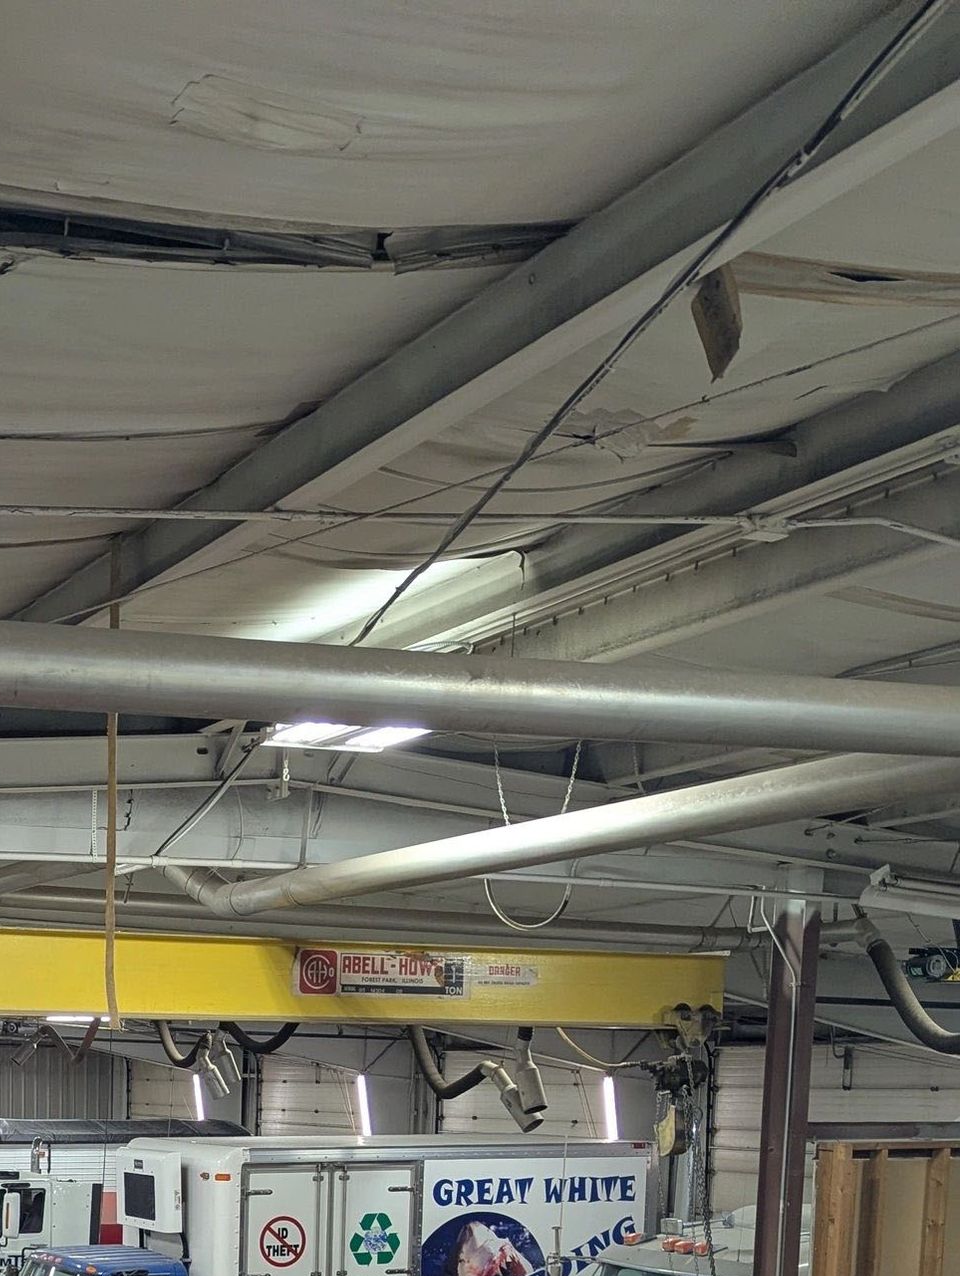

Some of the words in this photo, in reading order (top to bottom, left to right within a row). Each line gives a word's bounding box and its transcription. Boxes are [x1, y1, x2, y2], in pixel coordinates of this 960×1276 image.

[342, 956, 440, 976] ABELL-HOW
[488, 965, 521, 976] DANGER
[445, 986, 463, 995] TON
[433, 1176, 535, 1207] GREAT
[544, 1175, 637, 1204] WHITE
[277, 1227, 289, 1240] ID
[266, 1244, 300, 1258] THEFT
